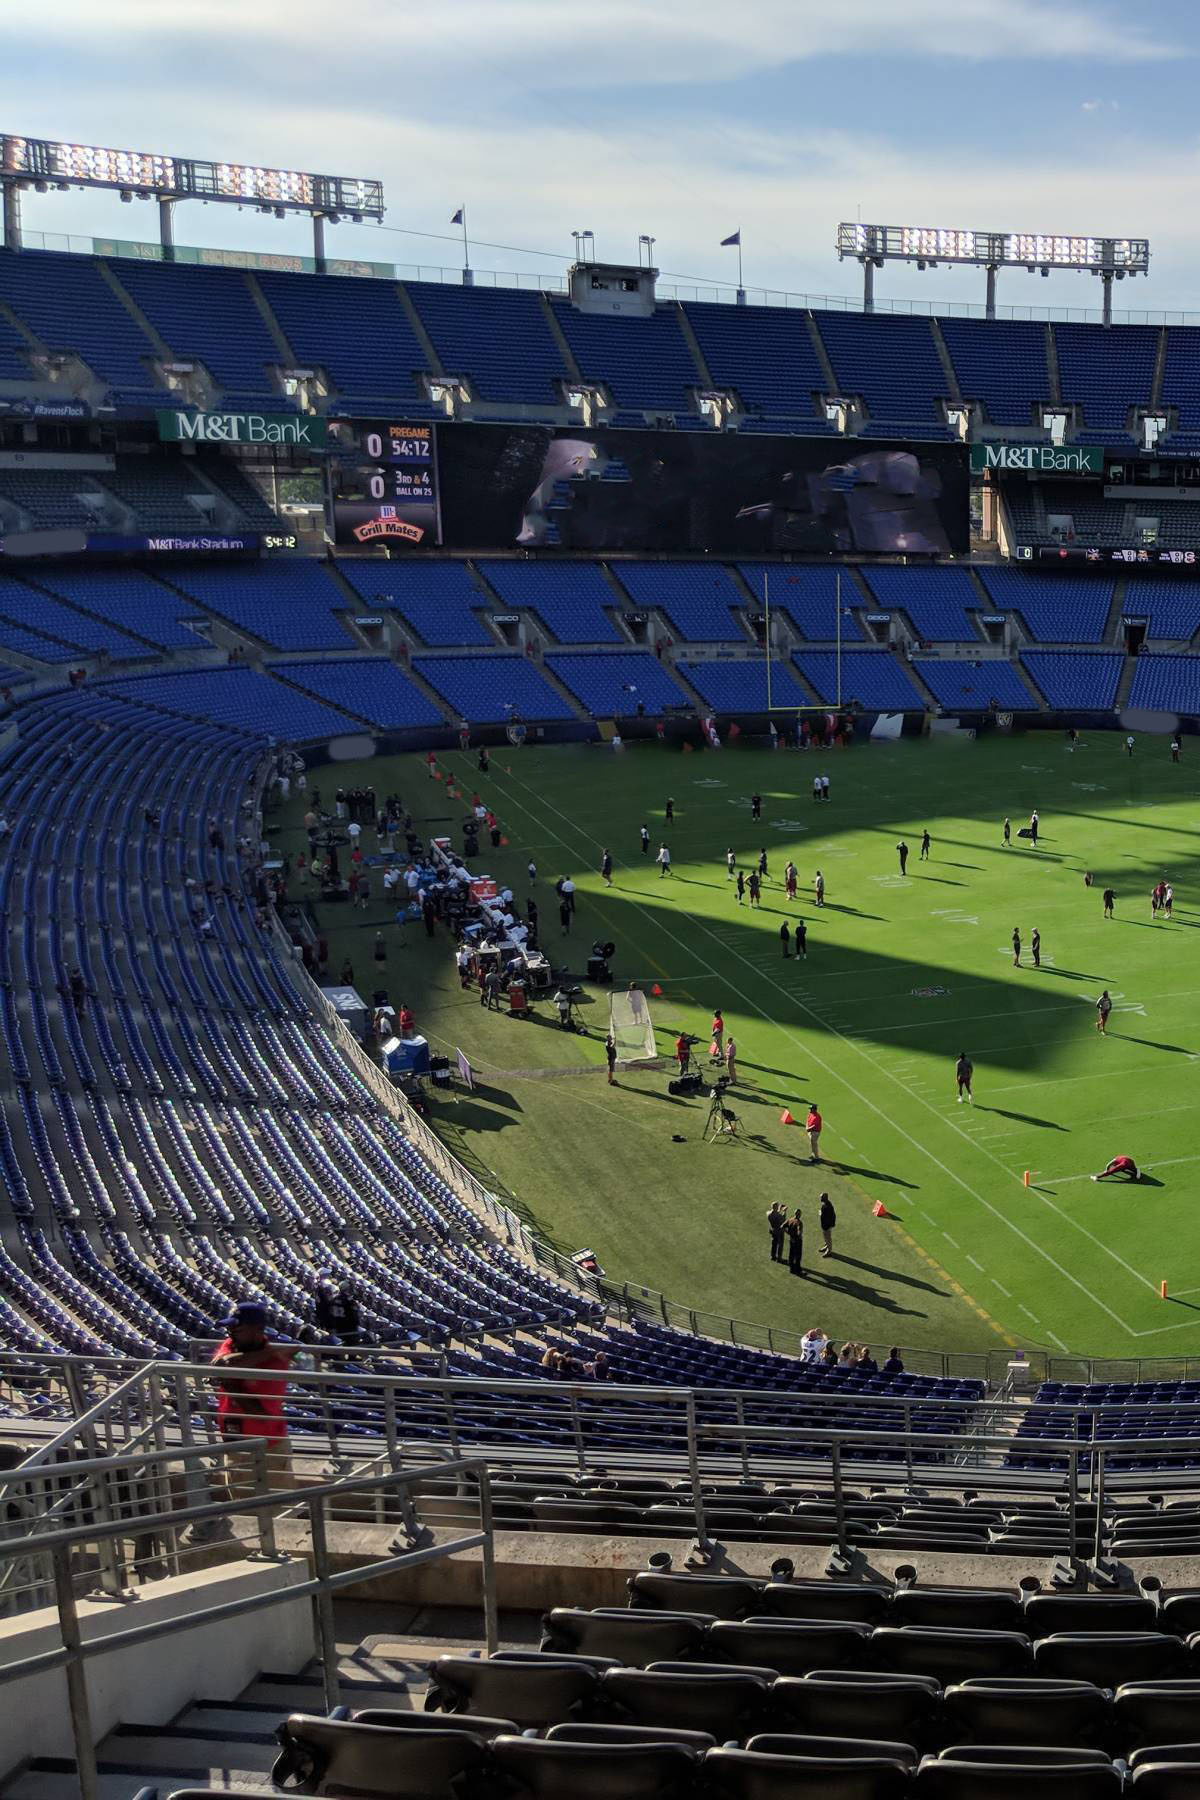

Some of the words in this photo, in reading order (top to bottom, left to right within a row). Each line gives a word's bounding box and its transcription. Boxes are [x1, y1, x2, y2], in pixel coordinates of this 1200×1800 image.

[176, 413, 245, 440] M&T
[248, 416, 311, 443] Bank
[390, 427, 431, 439] PREGAME
[368, 434, 382, 457] 0
[392, 440, 430, 456] 54:12
[985, 445, 1038, 469] M&T
[1041, 448, 1091, 471] Bank
[422, 472, 430, 484] 4
[371, 476, 385, 498] 0
[360, 524, 382, 537] Grill
[385, 524, 417, 537] Mates
[148, 539, 174, 550] M&T
[175, 539, 200, 550] Bank
[265, 536, 296, 548] 54:12
